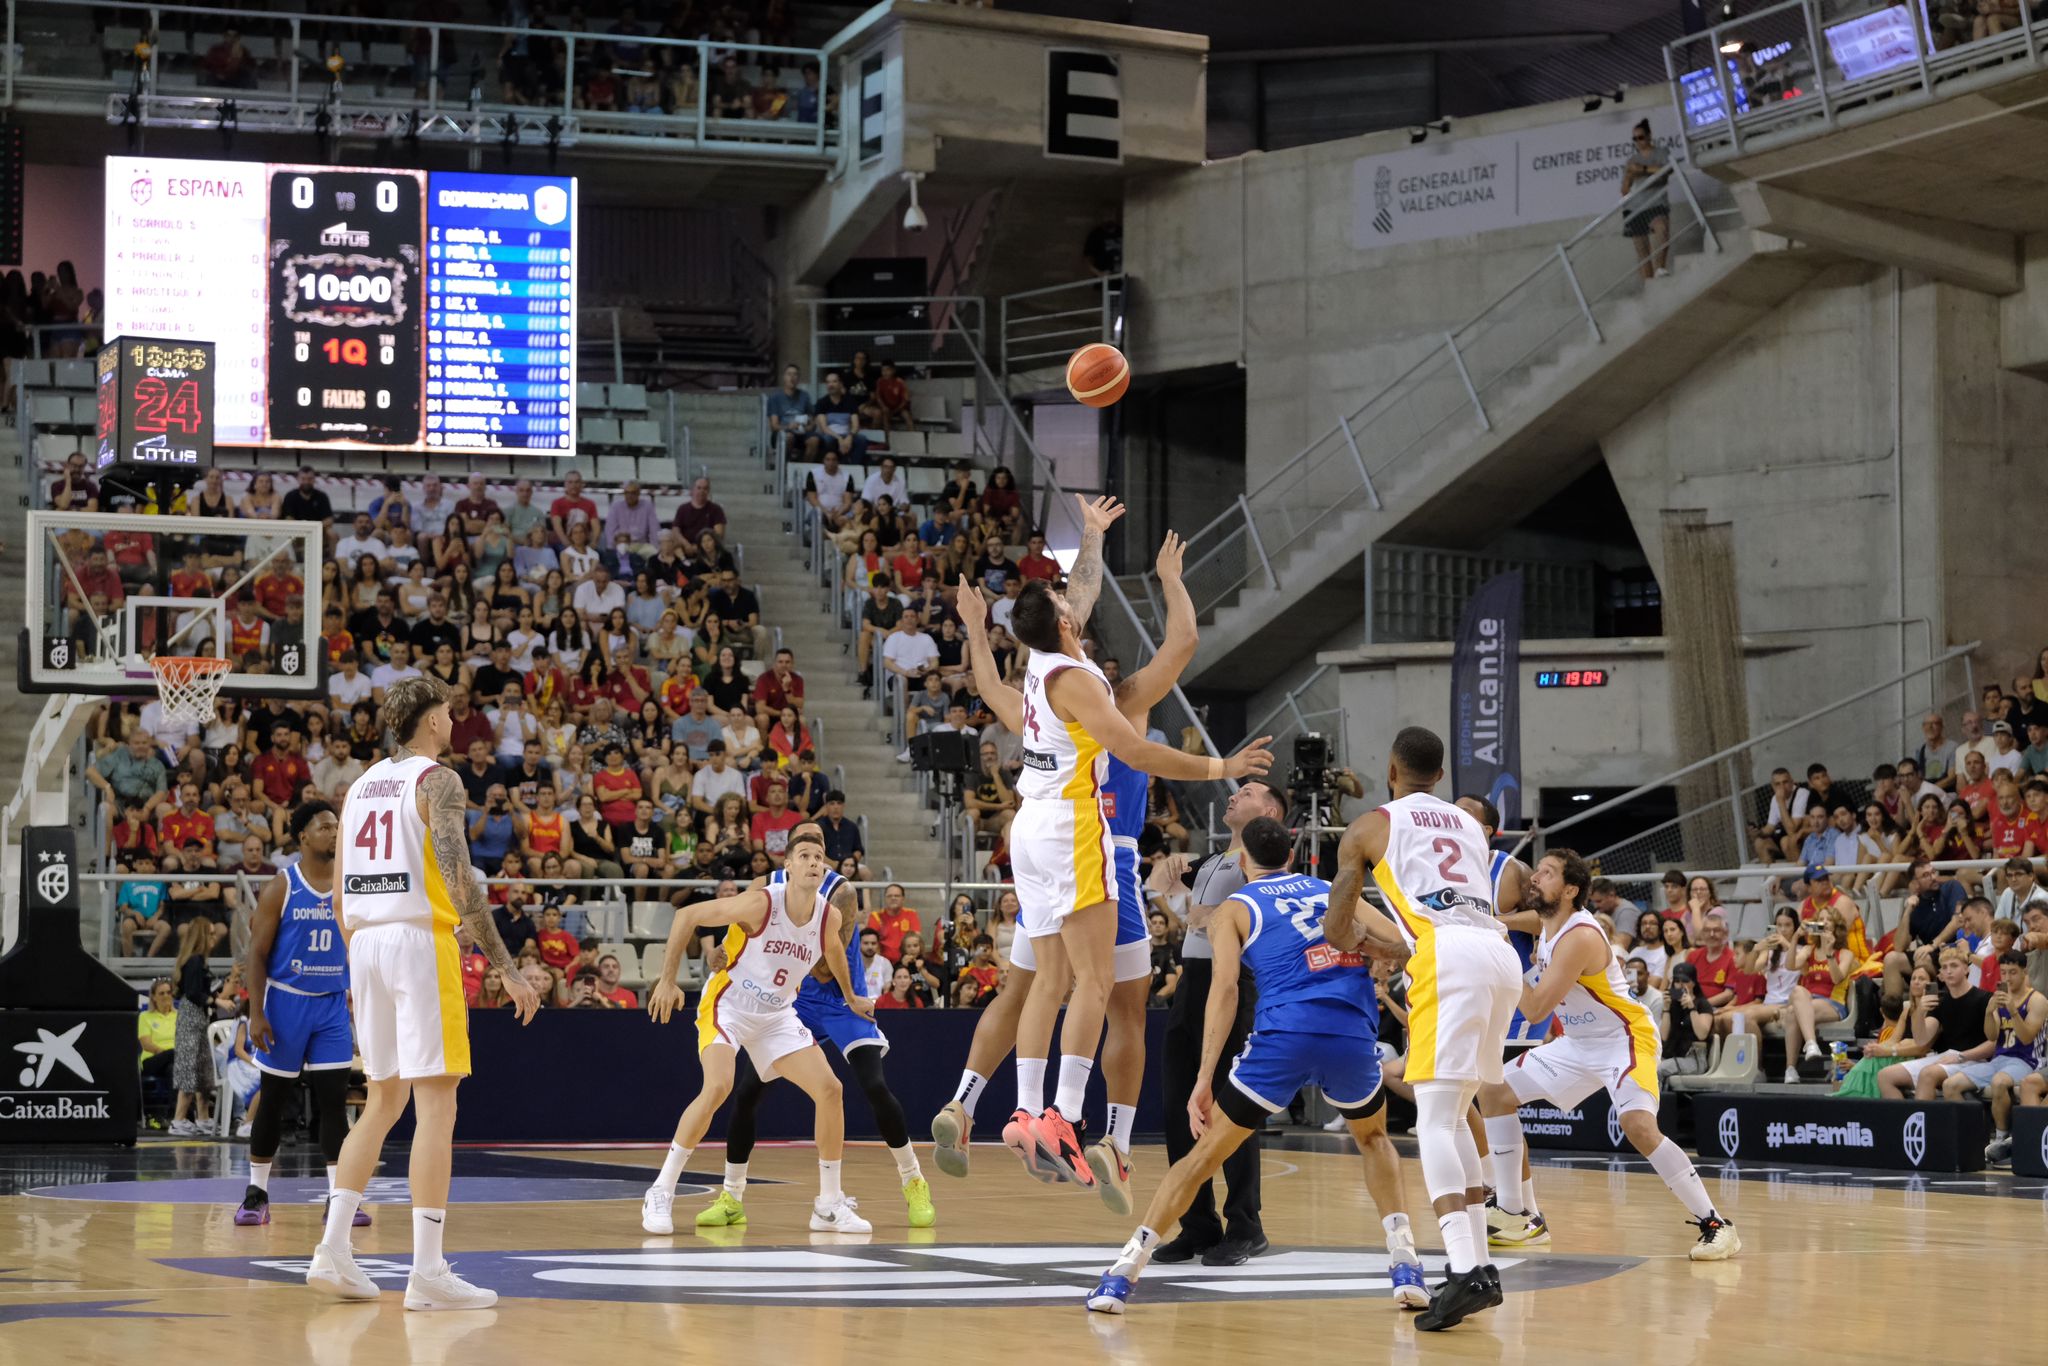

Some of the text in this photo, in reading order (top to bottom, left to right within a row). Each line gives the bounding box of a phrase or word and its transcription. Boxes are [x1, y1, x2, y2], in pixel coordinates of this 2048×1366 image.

[860, 51, 882, 161] E
[1048, 51, 1119, 159] E
[1533, 153, 1583, 171] CENTRE
[1586, 150, 1604, 163] DE
[1399, 164, 1498, 194] GENERALITAT
[292, 177, 314, 209] 0
[376, 180, 398, 212] 0
[1400, 188, 1496, 214] VALENCIANA
[320, 231, 370, 248] LOTUS
[298, 273, 392, 303] 10:00
[295, 337, 394, 366] 0 1Q 0
[134, 377, 202, 433] 24
[297, 387, 391, 409] 0 FALTAS 0
[133, 446, 198, 464] LOTUS
[1473, 618, 1499, 766] Alicante
[1461, 692, 1473, 766] DEPORTES
[1410, 811, 1464, 830] BROWN
[355, 810, 394, 861] 41
[1432, 837, 1469, 884] 2
[348, 875, 406, 893] CaixaBank
[1258, 879, 1316, 896] DUARTE
[308, 928, 332, 952] 10
[763, 939, 813, 965] ESPAÑA
[773, 968, 789, 987] 6
[0, 1096, 110, 1119] CaixaBank
[1517, 1104, 1538, 1119] CIÓN
[1521, 1123, 1572, 1136] ALONCESTO
[1766, 1121, 1874, 1148] #LaFamilia
